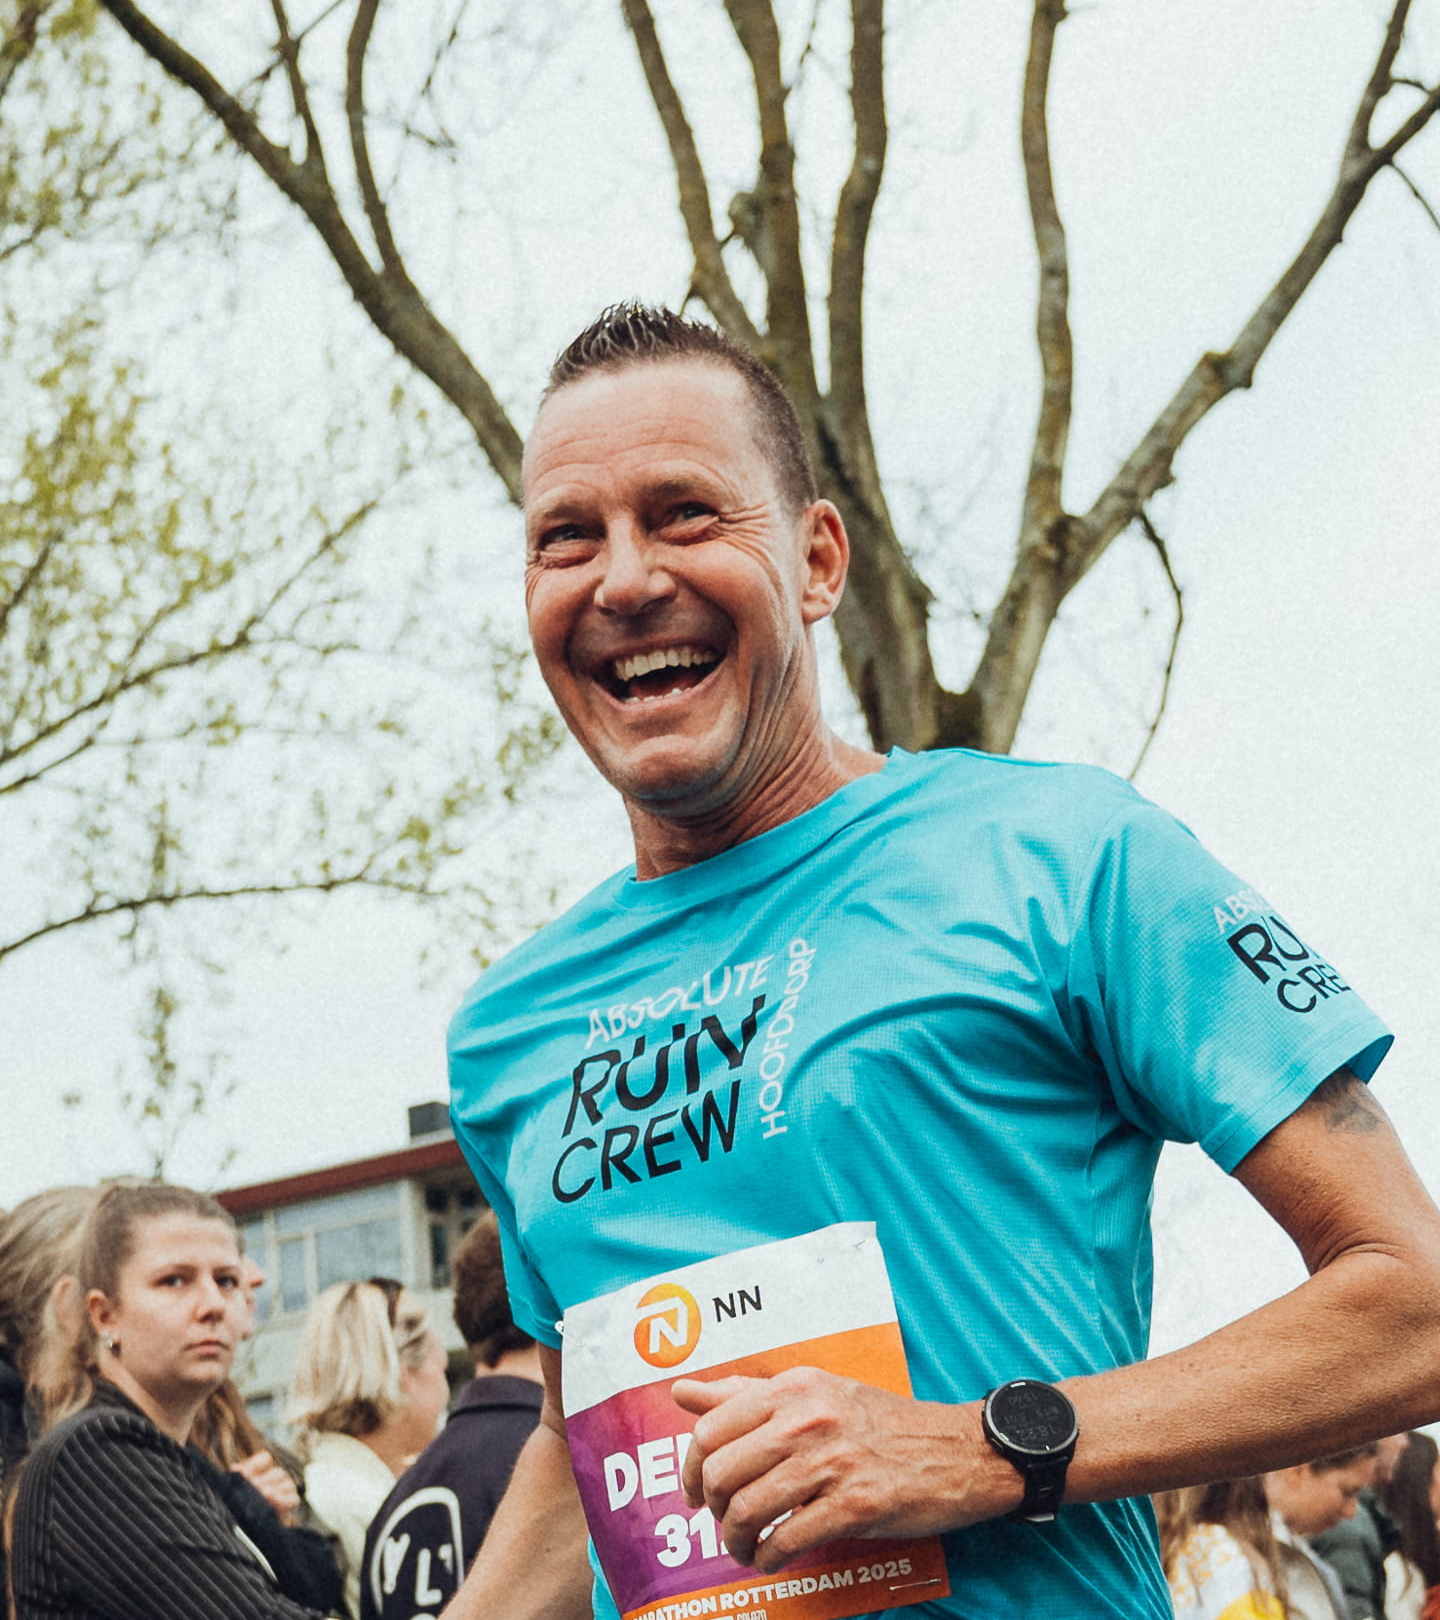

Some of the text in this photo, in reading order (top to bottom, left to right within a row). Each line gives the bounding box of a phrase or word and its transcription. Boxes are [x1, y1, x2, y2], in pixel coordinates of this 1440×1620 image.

[1227, 916, 1319, 984] RU
[584, 954, 775, 1050] ABSOLUTE
[1277, 964, 1351, 1013] CRE
[561, 994, 766, 1139] RUN
[759, 938, 816, 1140] HOOFDDORP
[552, 1080, 741, 1203] CREW
[712, 1285, 762, 1323] NN
[654, 1506, 729, 1568] 31
[720, 1570, 854, 1611] ROTTERDAM
[857, 1558, 912, 1584] 2025
